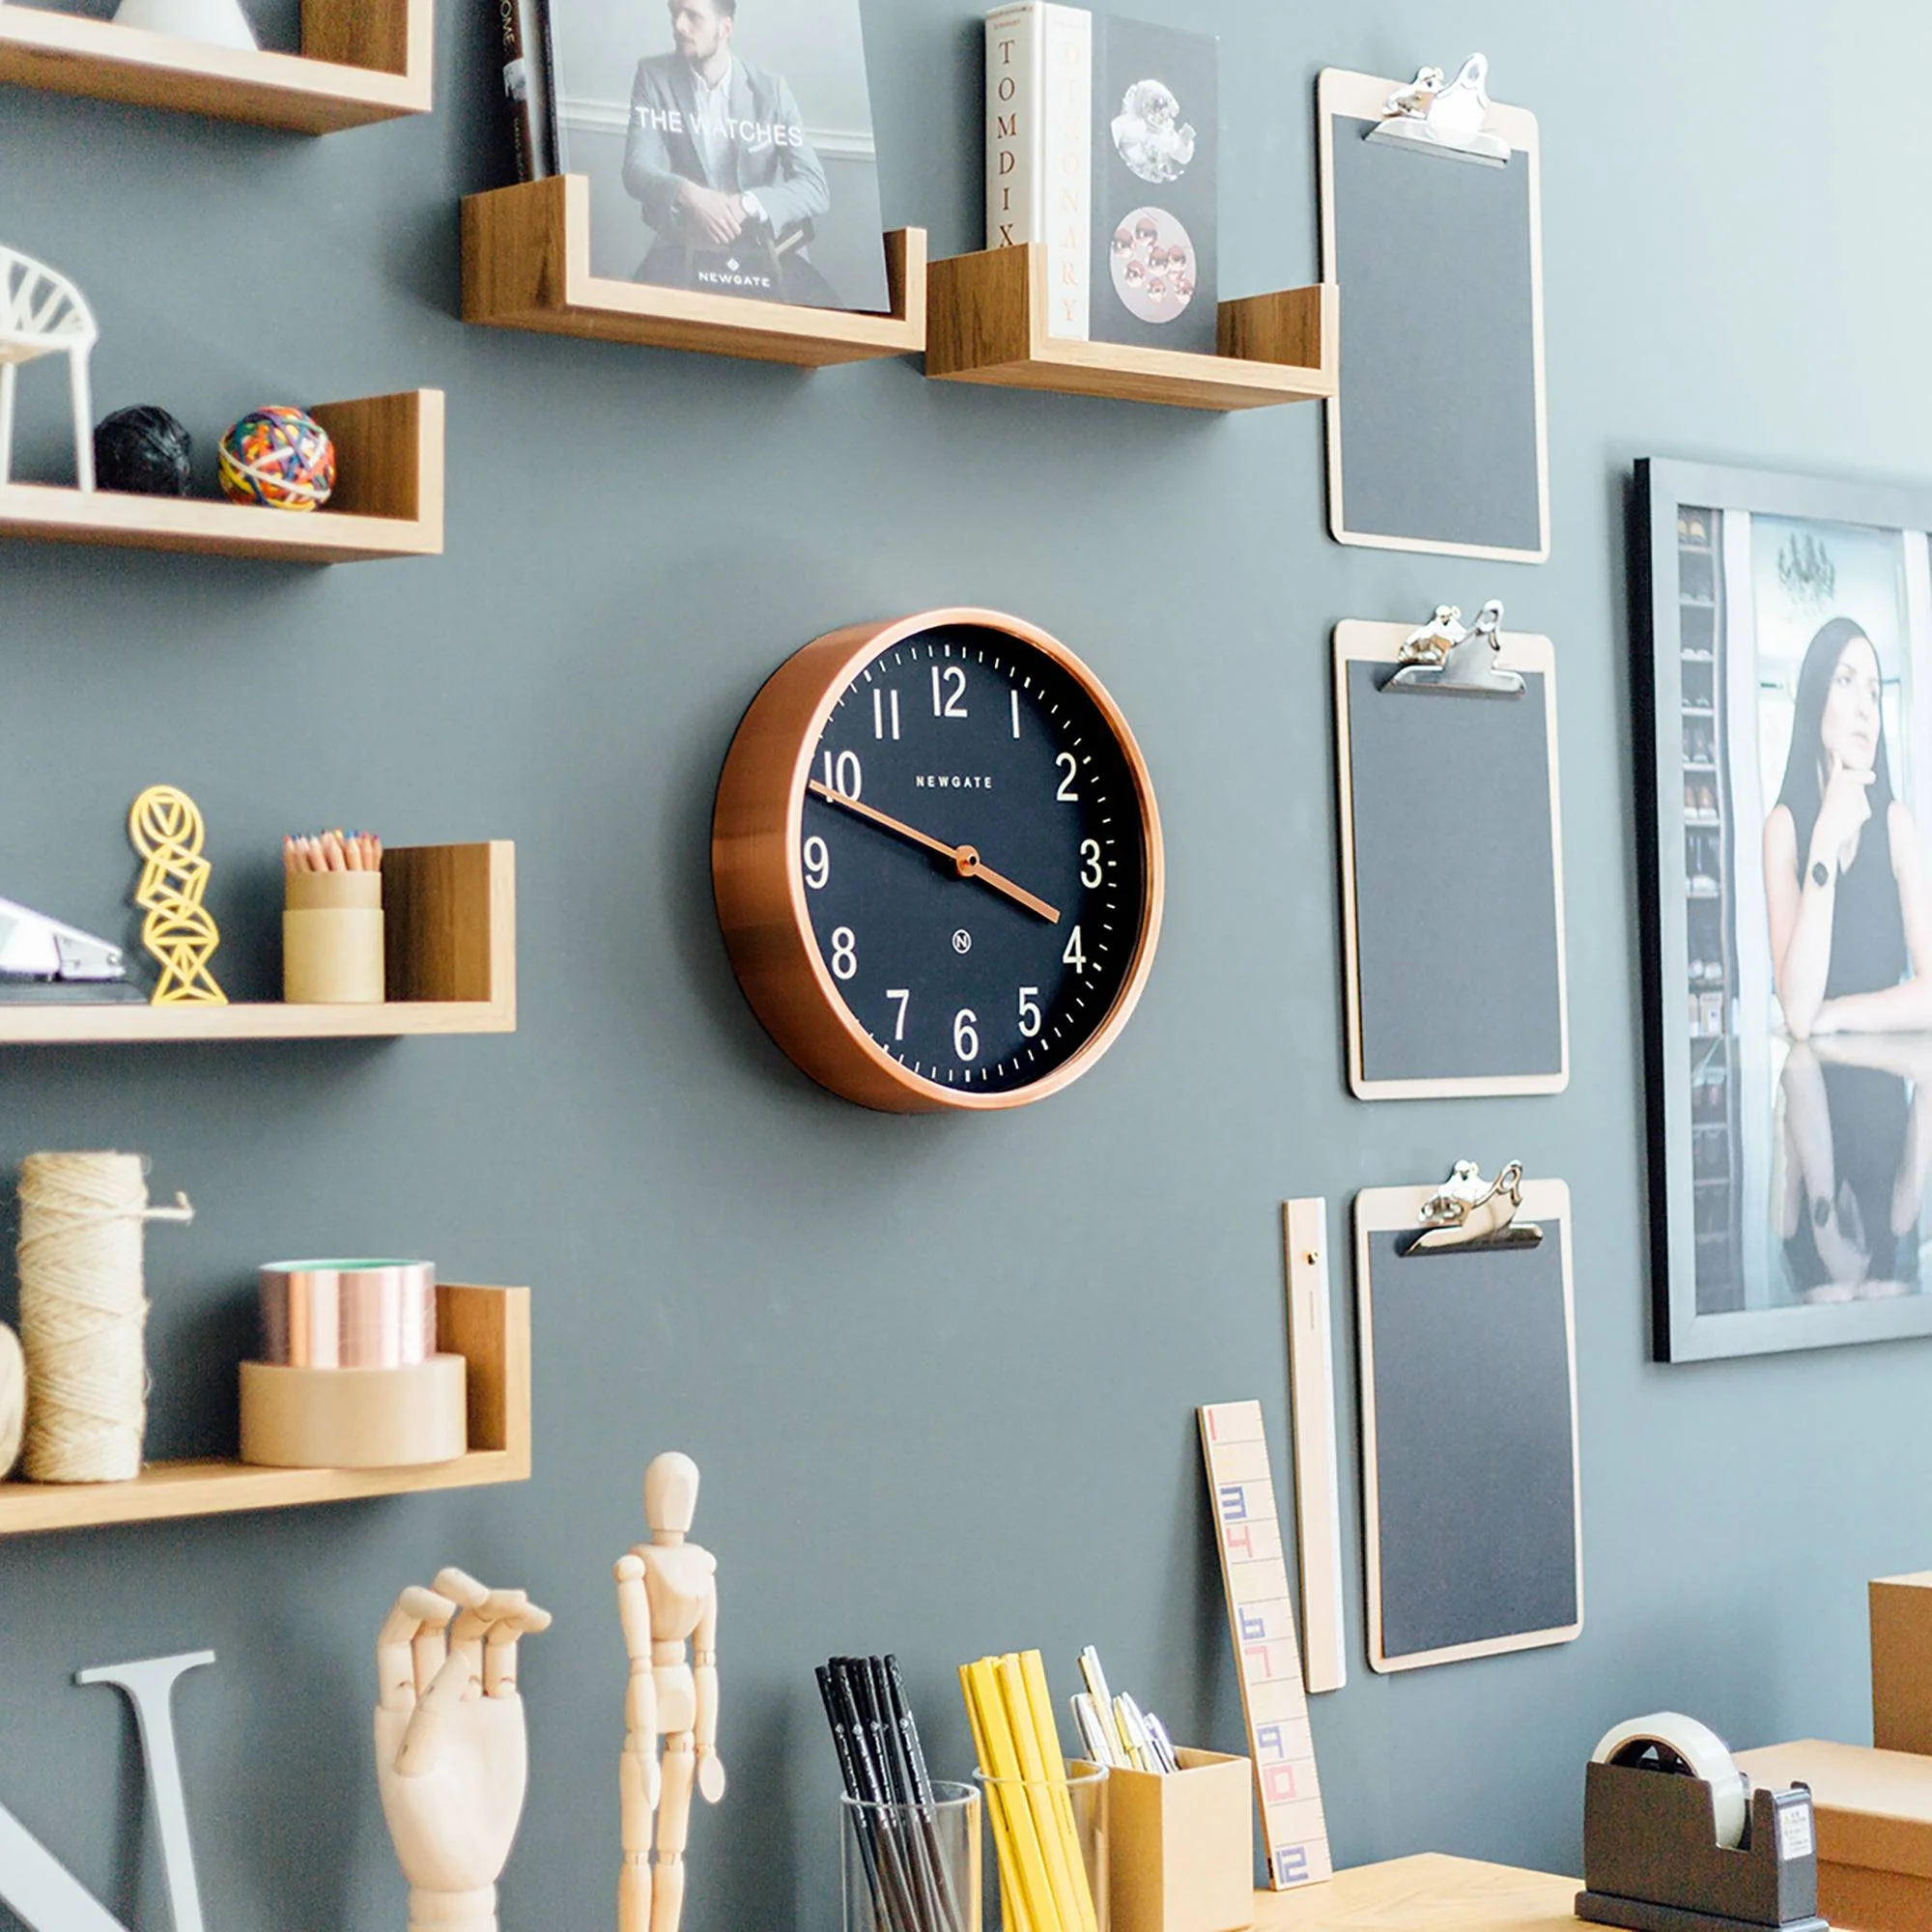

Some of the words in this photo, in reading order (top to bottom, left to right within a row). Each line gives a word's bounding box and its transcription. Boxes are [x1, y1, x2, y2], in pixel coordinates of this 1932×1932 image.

[634, 105, 683, 134] THE
[688, 112, 803, 148] WATCHES
[698, 270, 771, 289] NEWGATE
[873, 688, 900, 741] 11
[932, 666, 968, 718] 12
[1010, 690, 1020, 739] 1
[824, 750, 863, 803] 10
[916, 775, 994, 789] NEWGATE
[1056, 752, 1079, 802] 2
[804, 836, 830, 890] 9
[1080, 838, 1103, 889] 3
[831, 925, 858, 980] 8
[1062, 924, 1087, 974] 4
[886, 988, 910, 1041] 7
[953, 1008, 980, 1062] 6
[1018, 986, 1042, 1037] 5
[1226, 1524, 1253, 1558] 4
[1238, 1607, 1265, 1640] 6
[1244, 1645, 1271, 1678] 7
[1257, 1724, 1284, 1758] 9
[1275, 1845, 1309, 1885] 12
